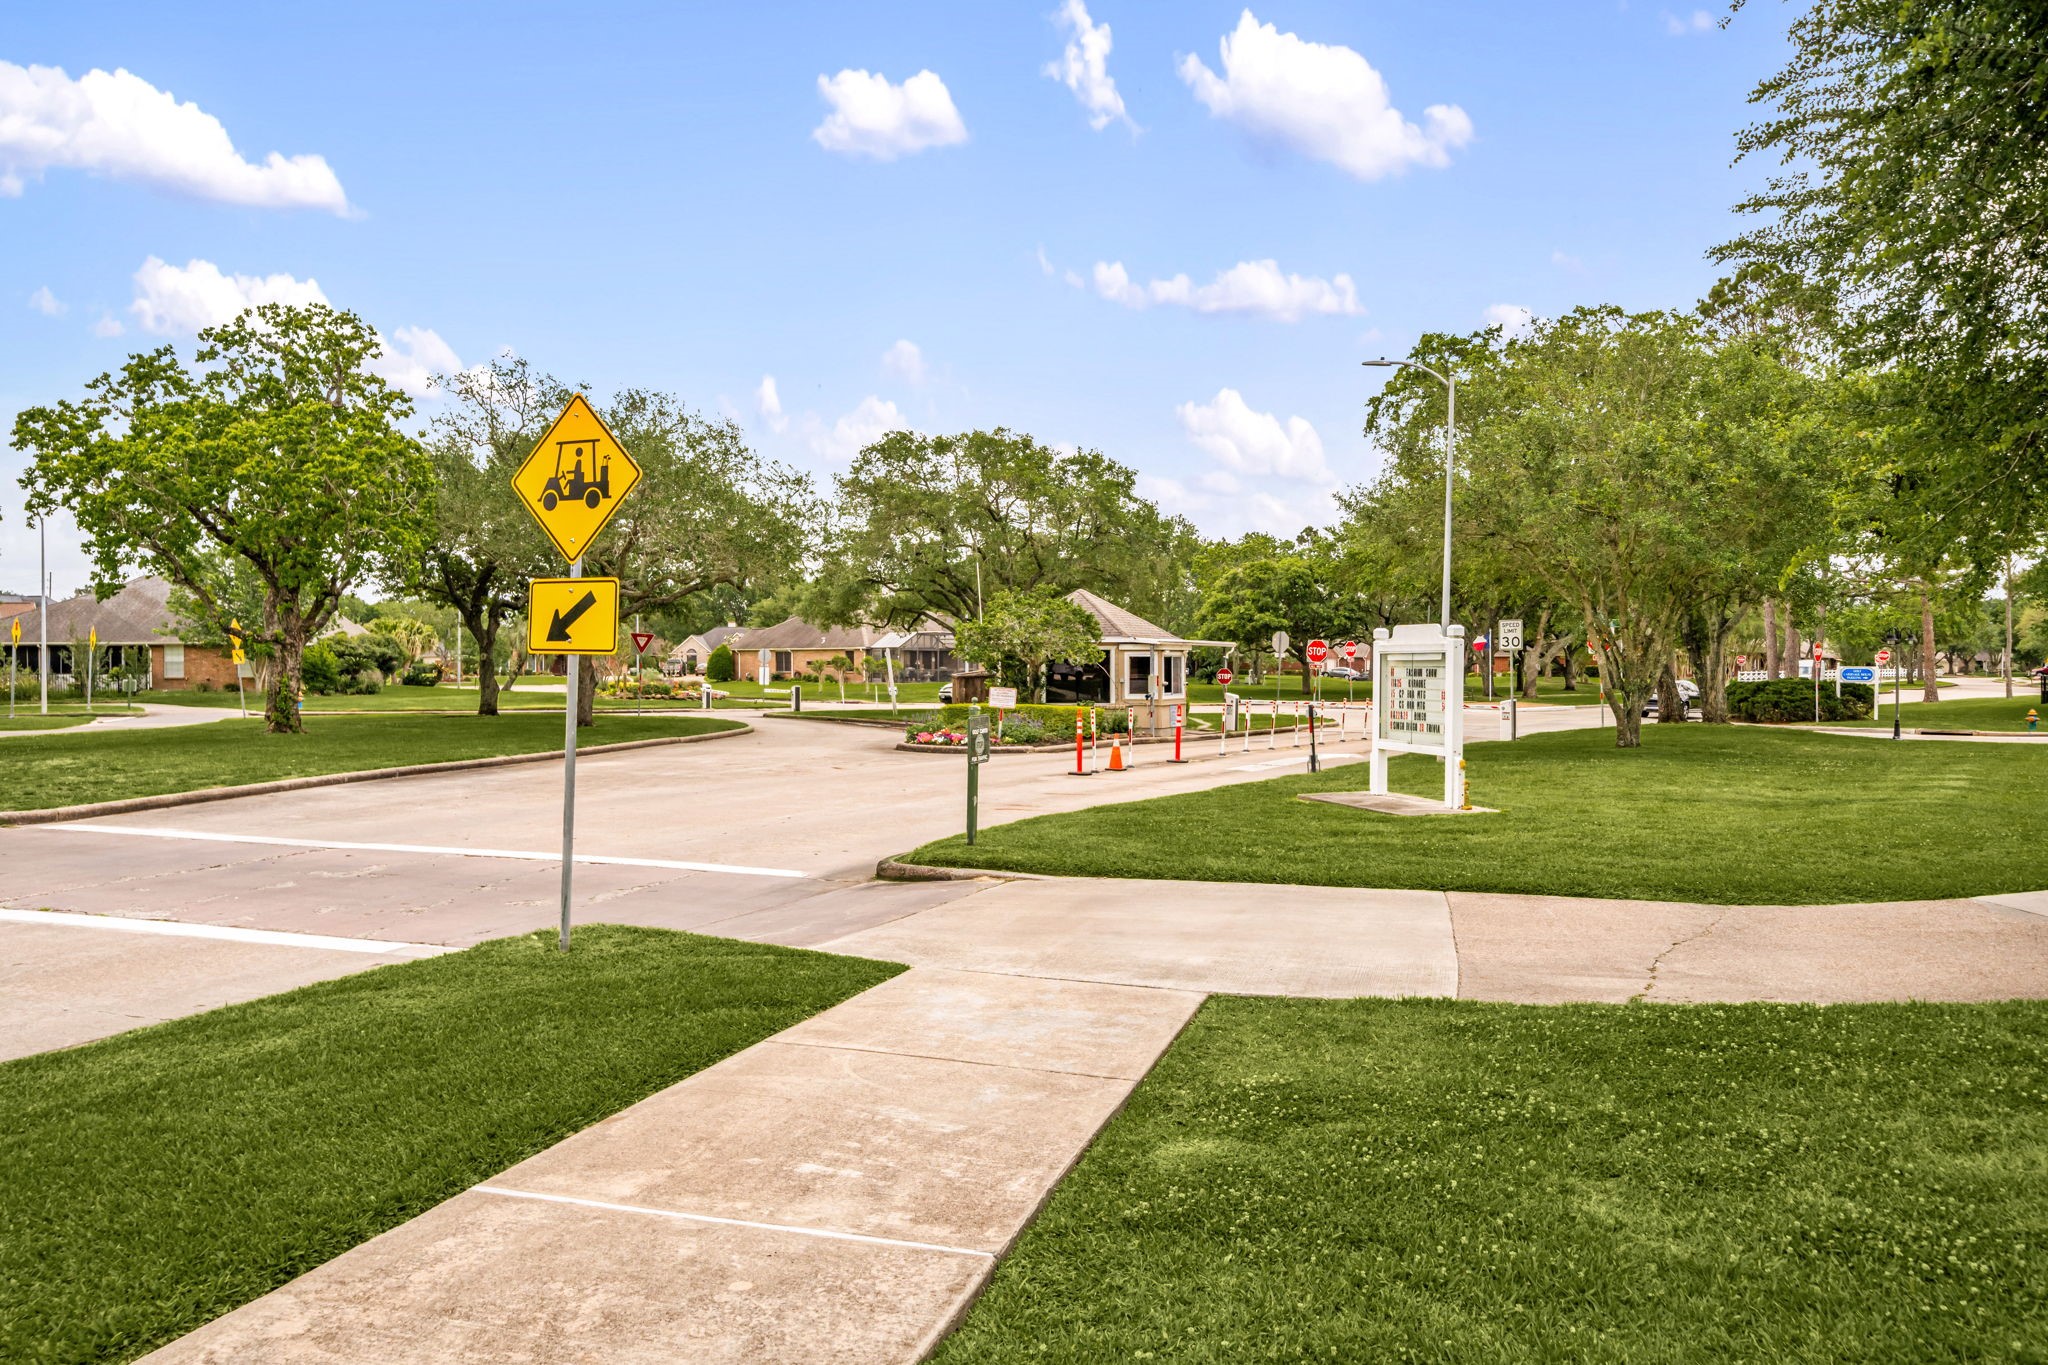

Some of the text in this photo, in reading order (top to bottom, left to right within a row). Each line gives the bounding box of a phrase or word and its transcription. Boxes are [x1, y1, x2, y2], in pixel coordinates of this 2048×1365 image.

[1502, 636, 1520, 647] 30
[1308, 646, 1327, 656] STOP
[1426, 668, 1437, 678] SHOW
[1408, 679, 1426, 688] KARAOKE
[1417, 690, 1426, 699] MTG
